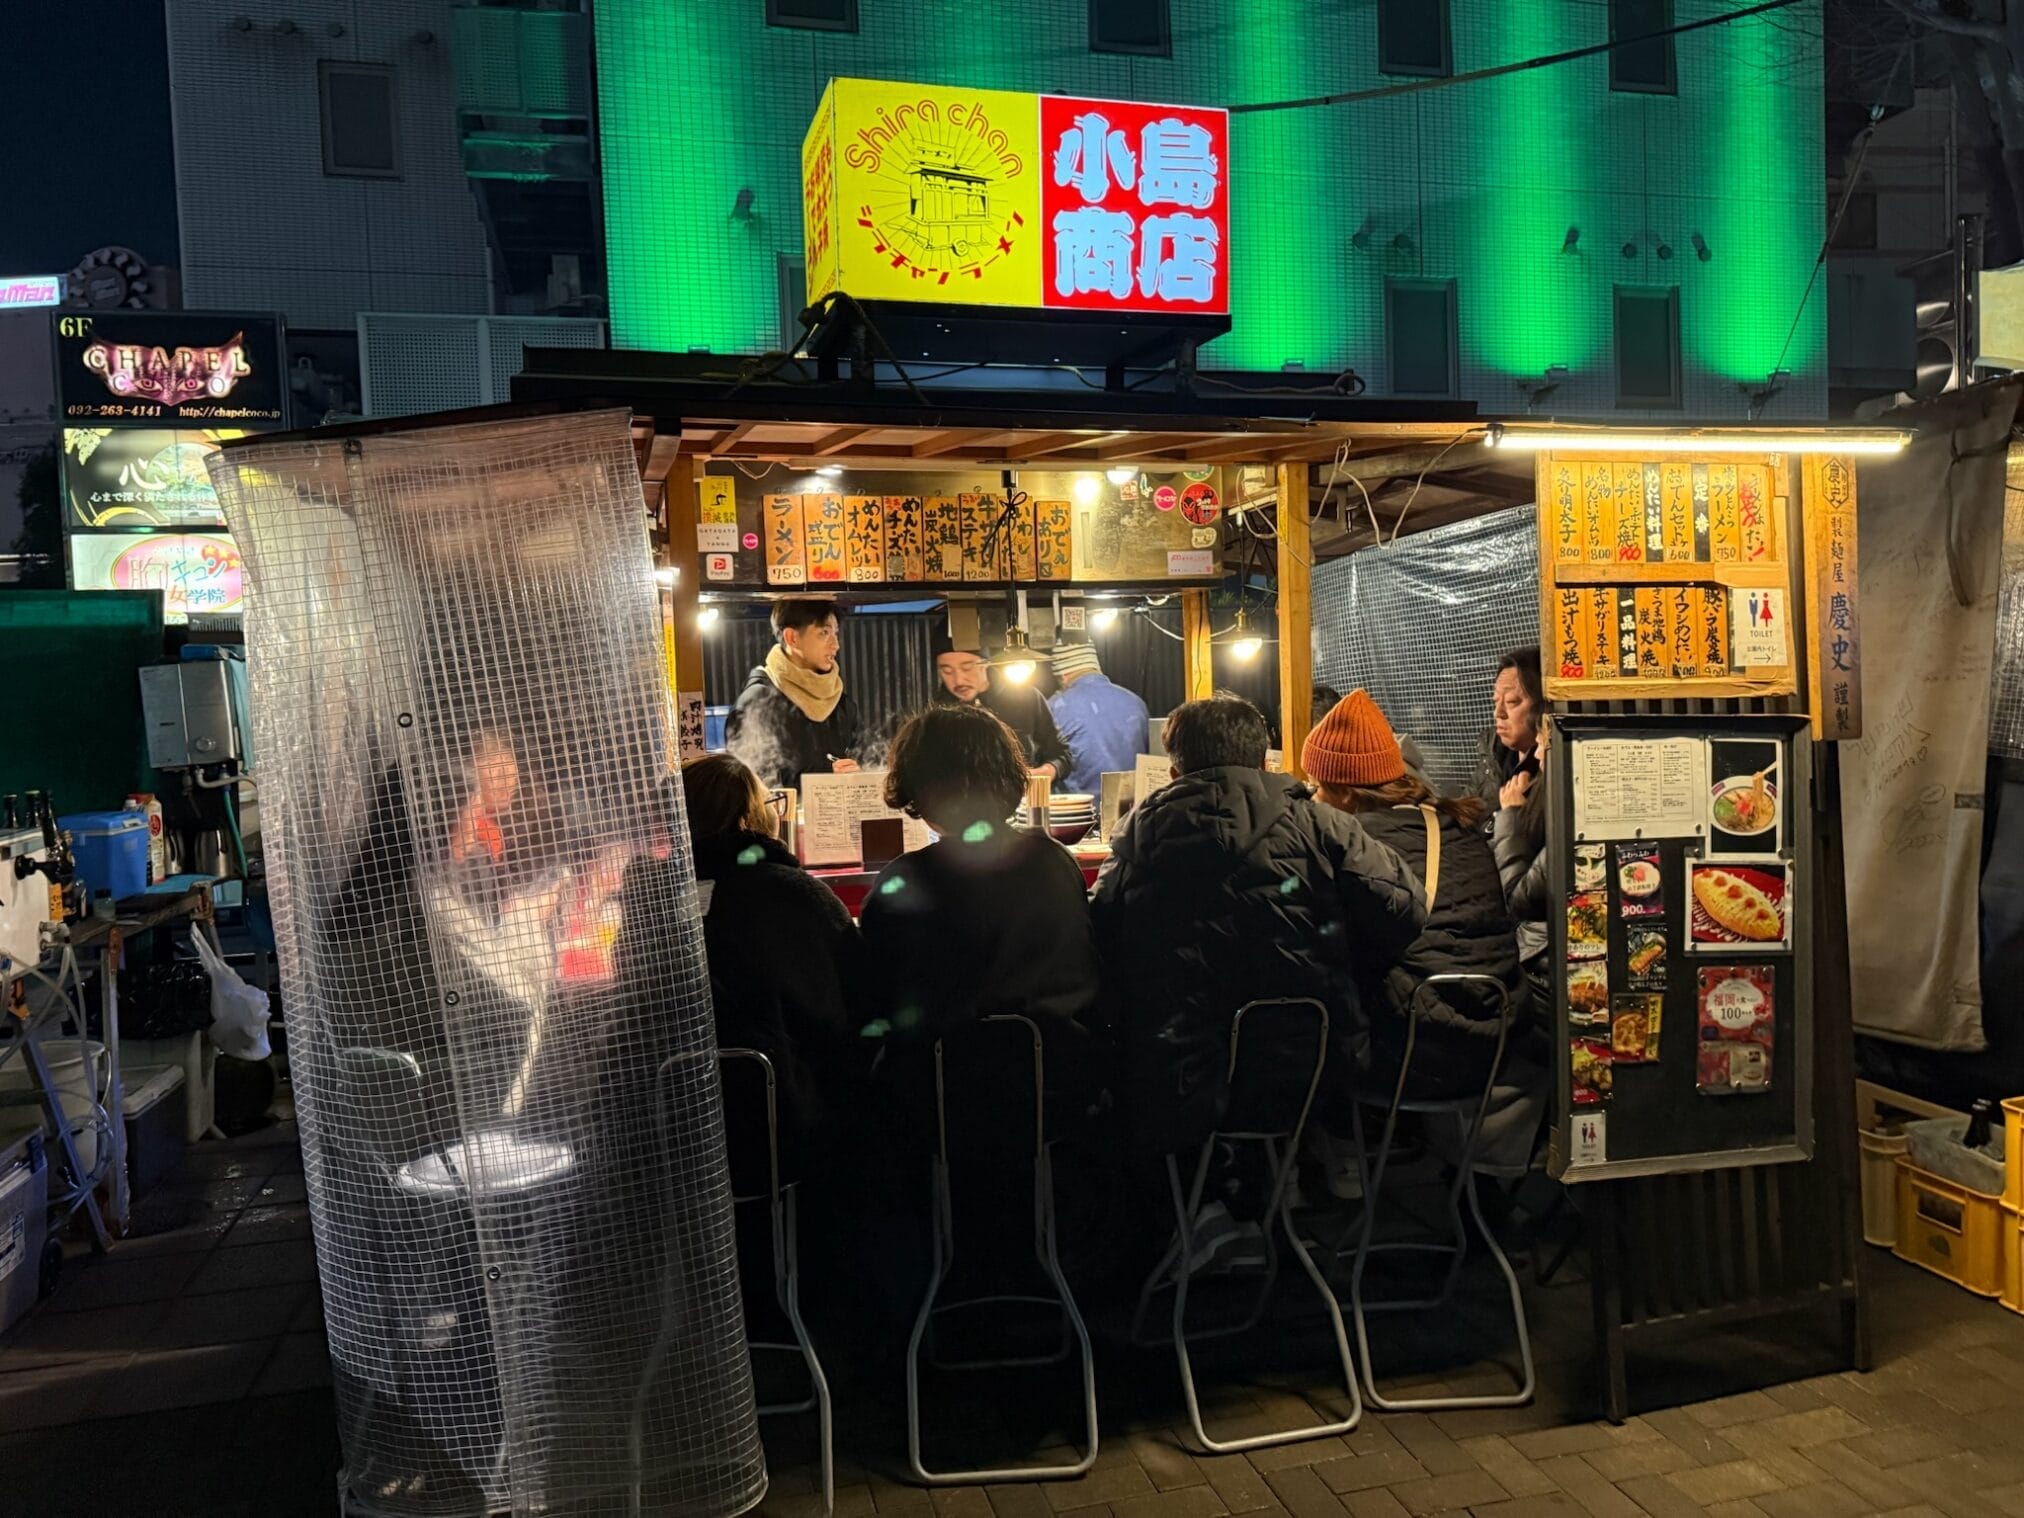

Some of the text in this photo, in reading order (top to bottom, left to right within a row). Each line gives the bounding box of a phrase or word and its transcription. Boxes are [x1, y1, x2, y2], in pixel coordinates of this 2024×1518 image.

[844, 99, 940, 173] Shira
[948, 102, 1023, 179] chan
[1053, 112, 1219, 209] 小島
[1053, 206, 1219, 302] 商店
[59, 316, 93, 338] 6F
[88, 348, 248, 373] CHAPEL
[68, 405, 162, 416] 092-263-4141
[901, 497, 921, 558] めんたい
[937, 502, 959, 545] 地鶏
[1712, 477, 1728, 545] ラーメン
[771, 497, 795, 565] ラーメン
[823, 497, 843, 561] おでん
[847, 505, 863, 567] オムレツ
[862, 499, 881, 564] めんたい
[1050, 504, 1070, 566] おでん
[1559, 546, 1580, 558] 800
[1590, 548, 1611, 560] 800
[773, 568, 802, 580] 750
[813, 566, 840, 580] 600
[854, 568, 879, 580] 800
[966, 569, 990, 580] 1200
[1620, 598, 1638, 669] 一品料理
[1750, 630, 1773, 638] TOILET
[1621, 904, 1644, 918] 900
[1721, 1007, 1742, 1020] 100
